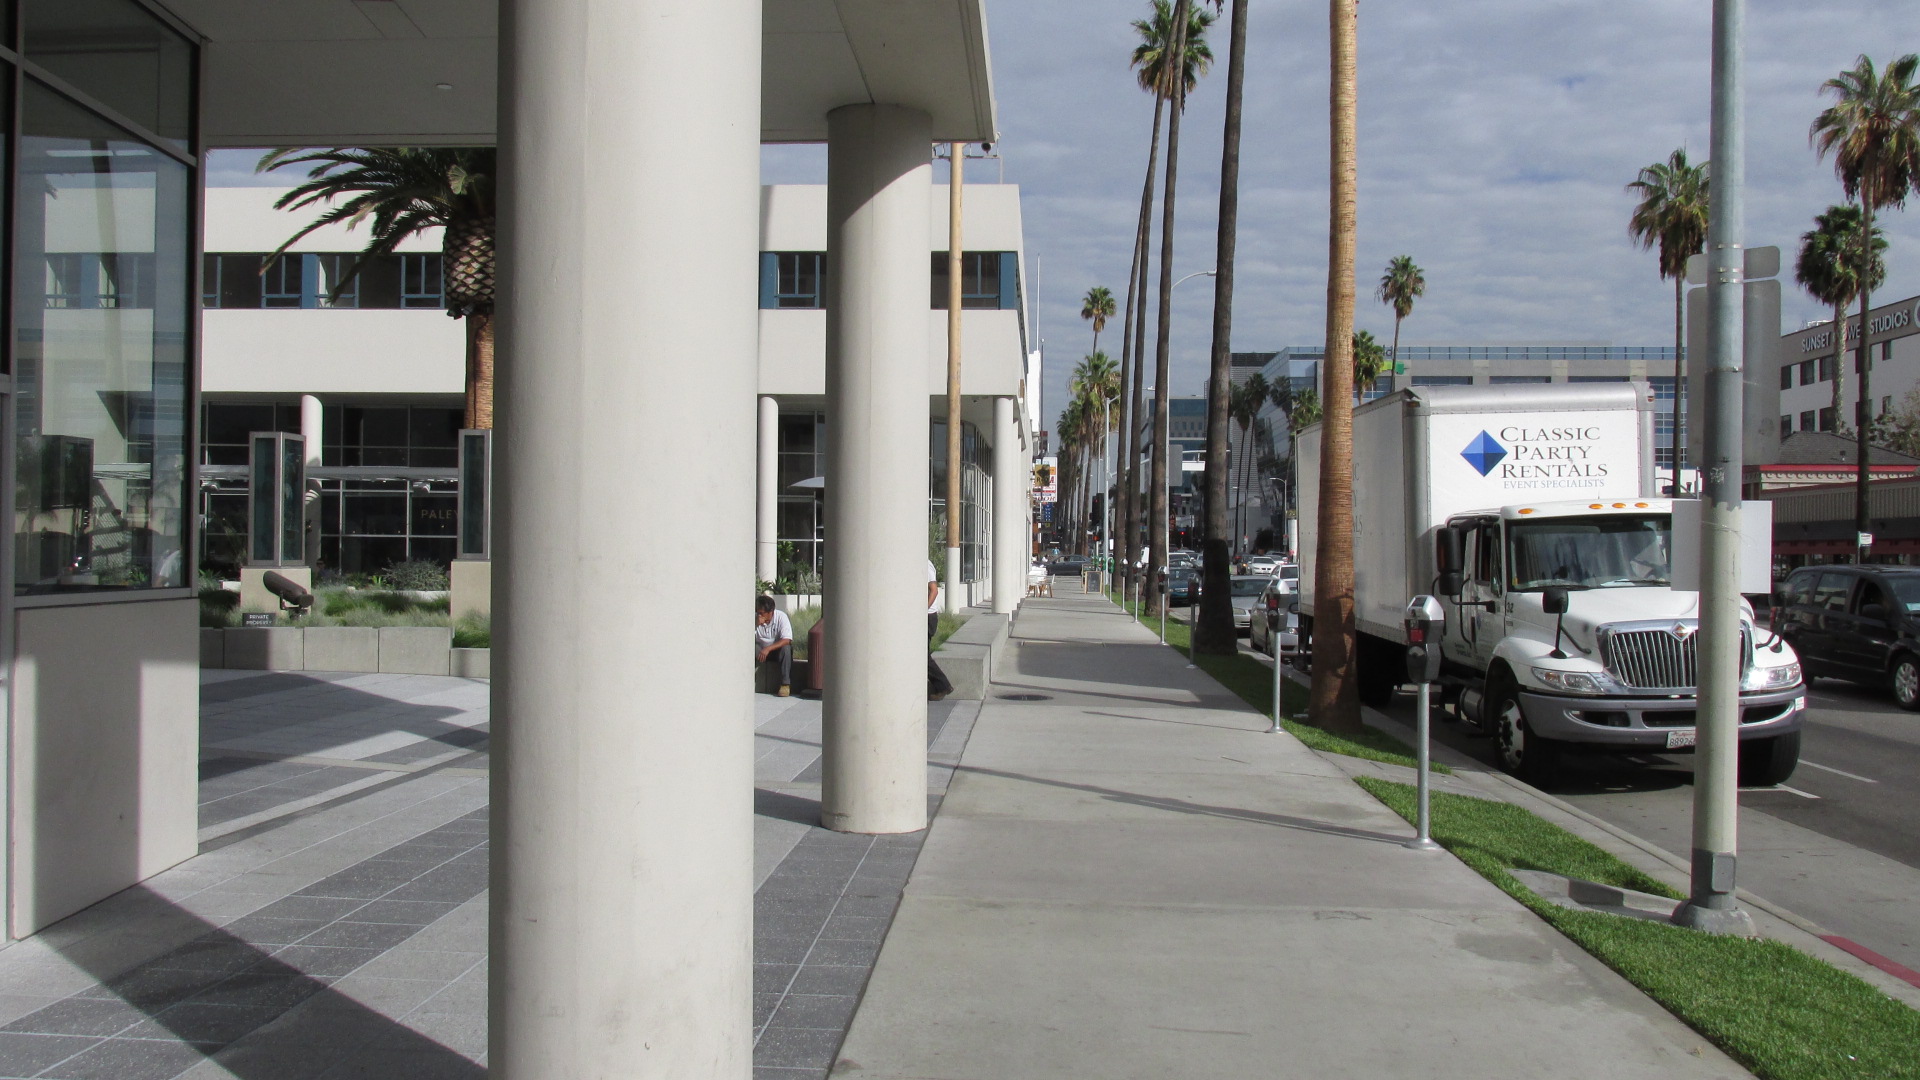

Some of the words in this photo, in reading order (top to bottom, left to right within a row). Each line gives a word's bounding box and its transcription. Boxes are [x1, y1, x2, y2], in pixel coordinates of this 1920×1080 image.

[1802, 331, 1831, 352] SUNSET
[1869, 309, 1909, 335] STUDIOS
[1500, 426, 1600, 442] CLASSIC
[1513, 445, 1592, 460] PARTY
[1501, 463, 1608, 478] RENTALS
[1503, 480, 1539, 489] EVENT
[1540, 479, 1605, 488] SPECIALISTS
